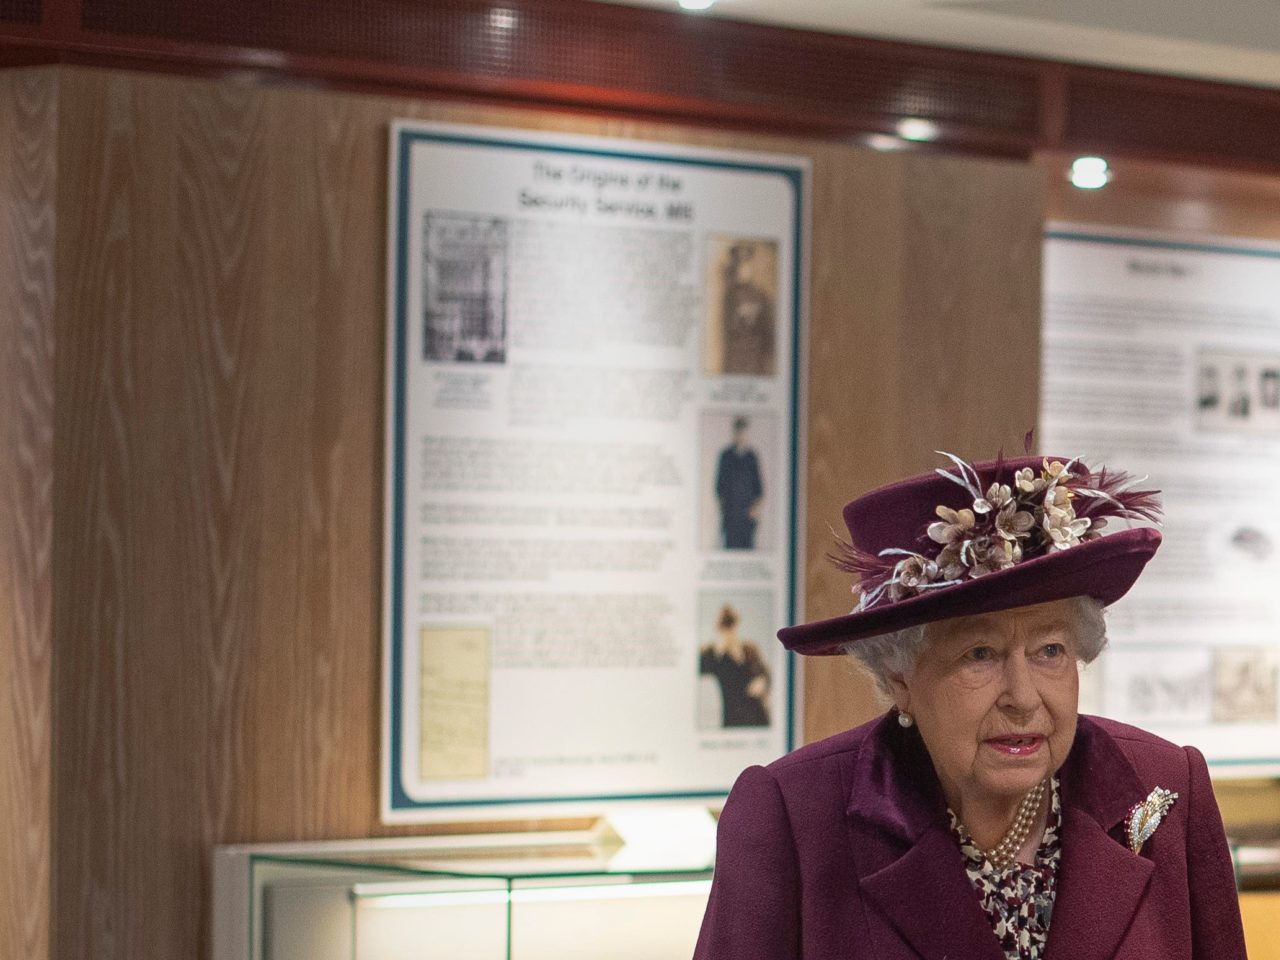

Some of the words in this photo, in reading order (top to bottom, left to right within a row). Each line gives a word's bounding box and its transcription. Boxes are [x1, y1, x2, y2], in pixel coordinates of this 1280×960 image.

[532, 160, 563, 181] The
[636, 172, 652, 188] of
[518, 187, 588, 215] Security
